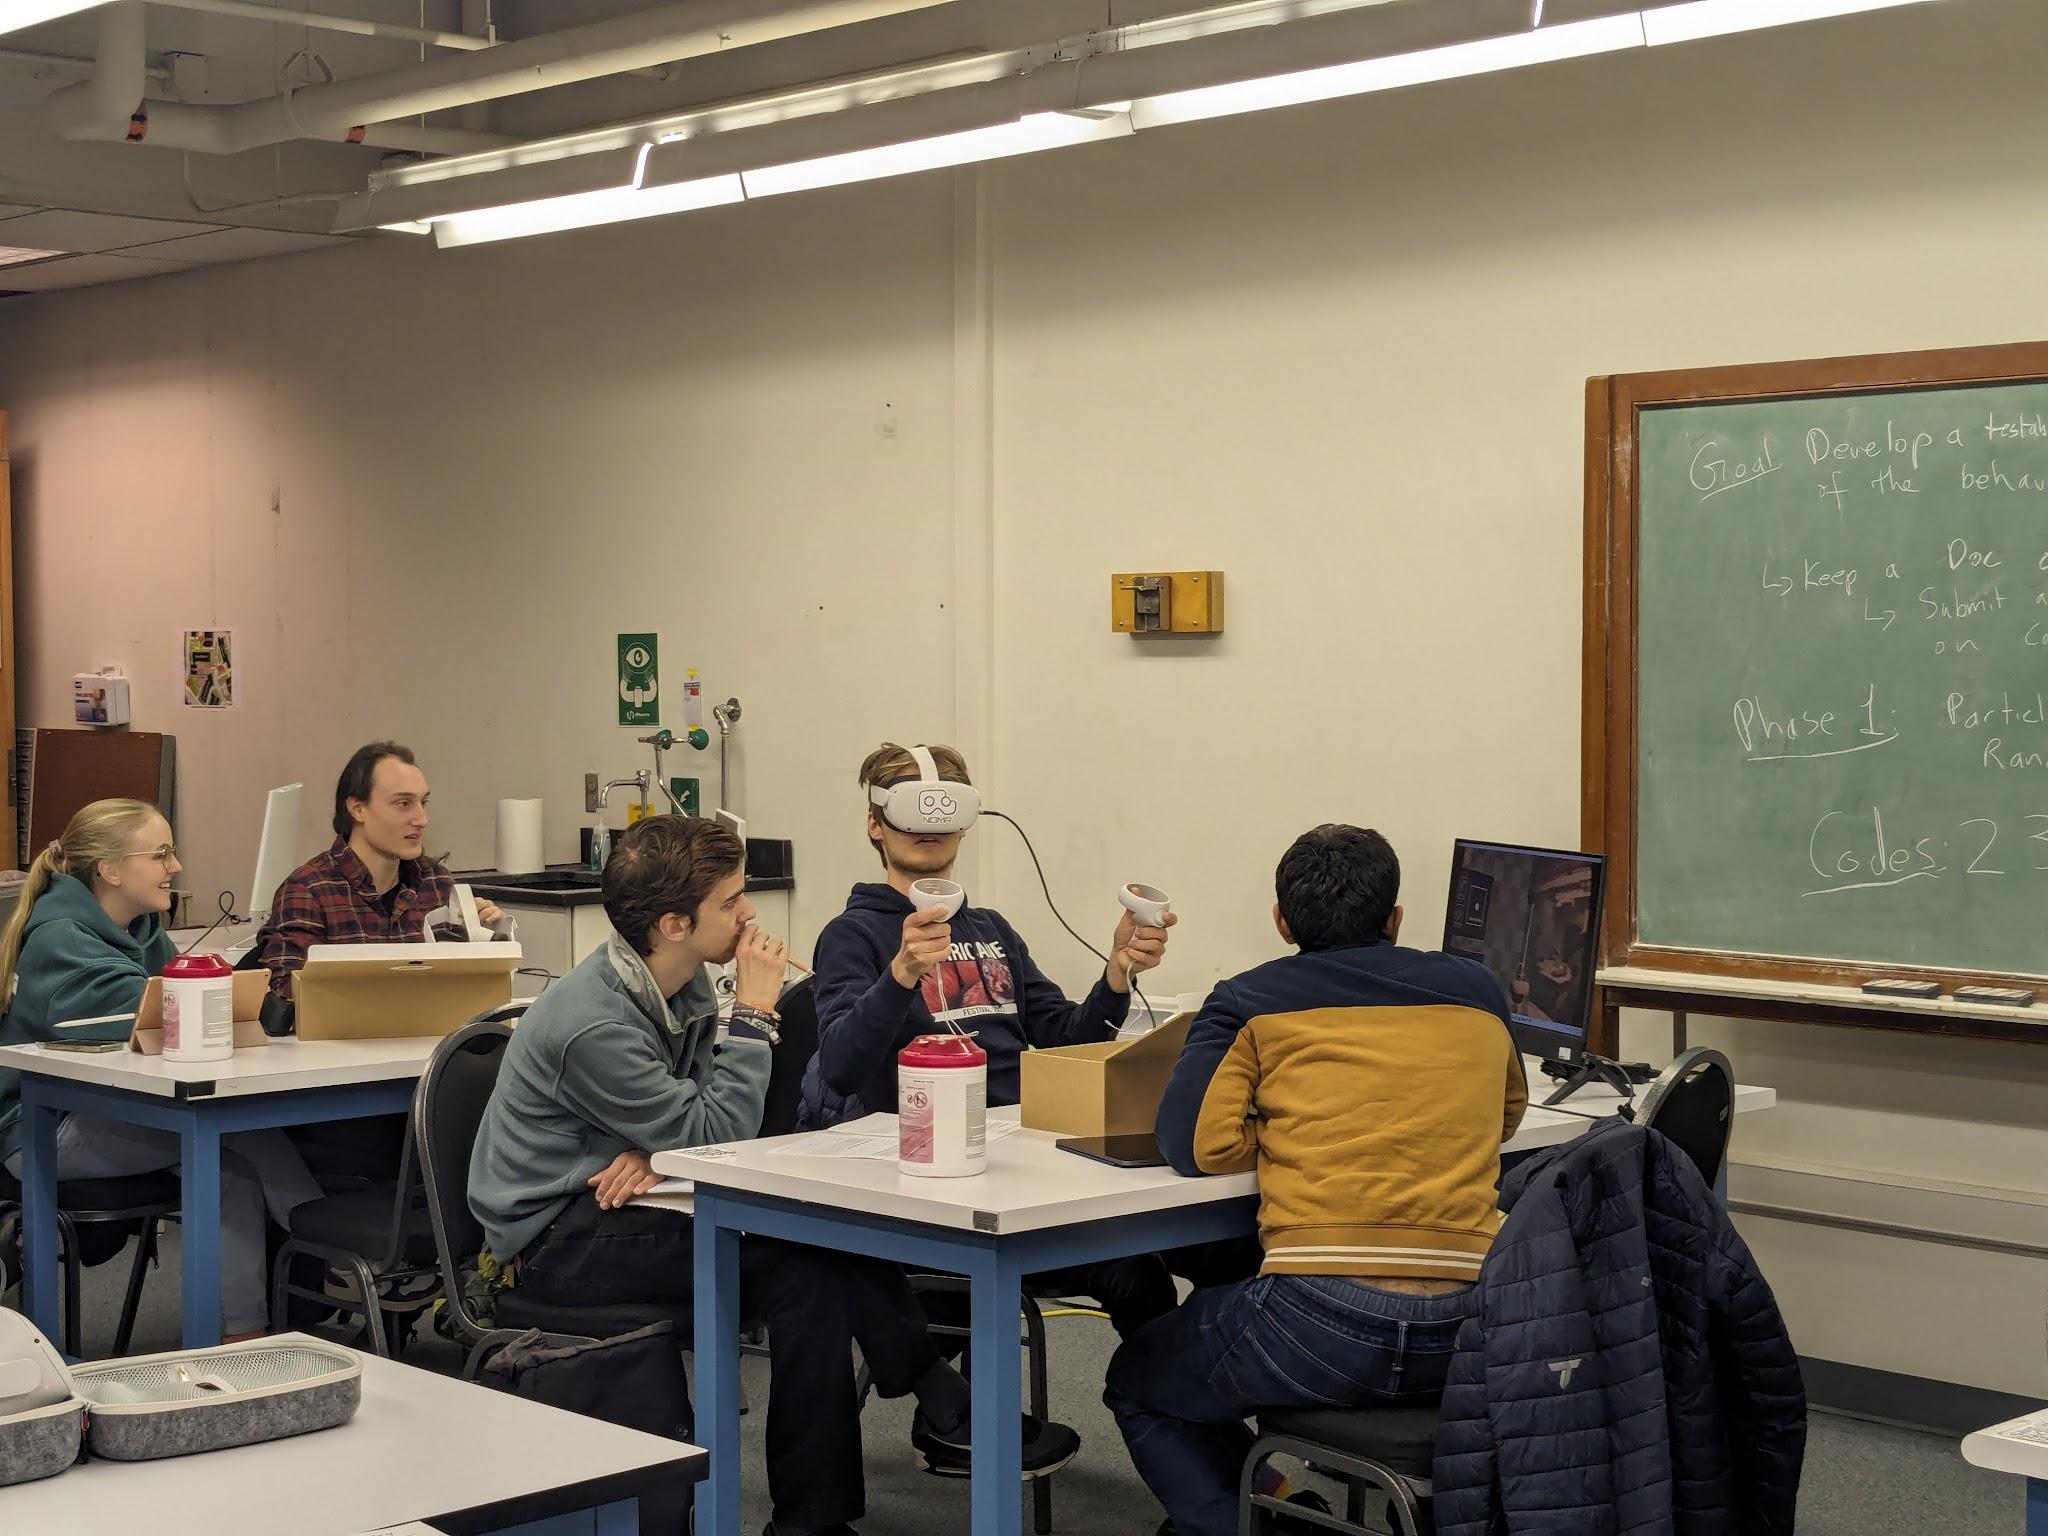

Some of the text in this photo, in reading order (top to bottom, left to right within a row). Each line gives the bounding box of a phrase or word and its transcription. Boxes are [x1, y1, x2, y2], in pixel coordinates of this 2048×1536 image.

[1806, 420, 1933, 469] Develop
[1947, 428, 1965, 446] a
[1817, 459, 2045, 510] of the behav
[1804, 558, 1857, 596] Keep
[1885, 563, 1900, 579] a
[1948, 538, 2002, 570] Doc
[1919, 586, 2007, 619] Submit
[1935, 639, 1979, 655] on
[1734, 695, 1835, 751] Phase
[1984, 738, 2048, 770] Ran
[1960, 818, 2006, 873] 2
